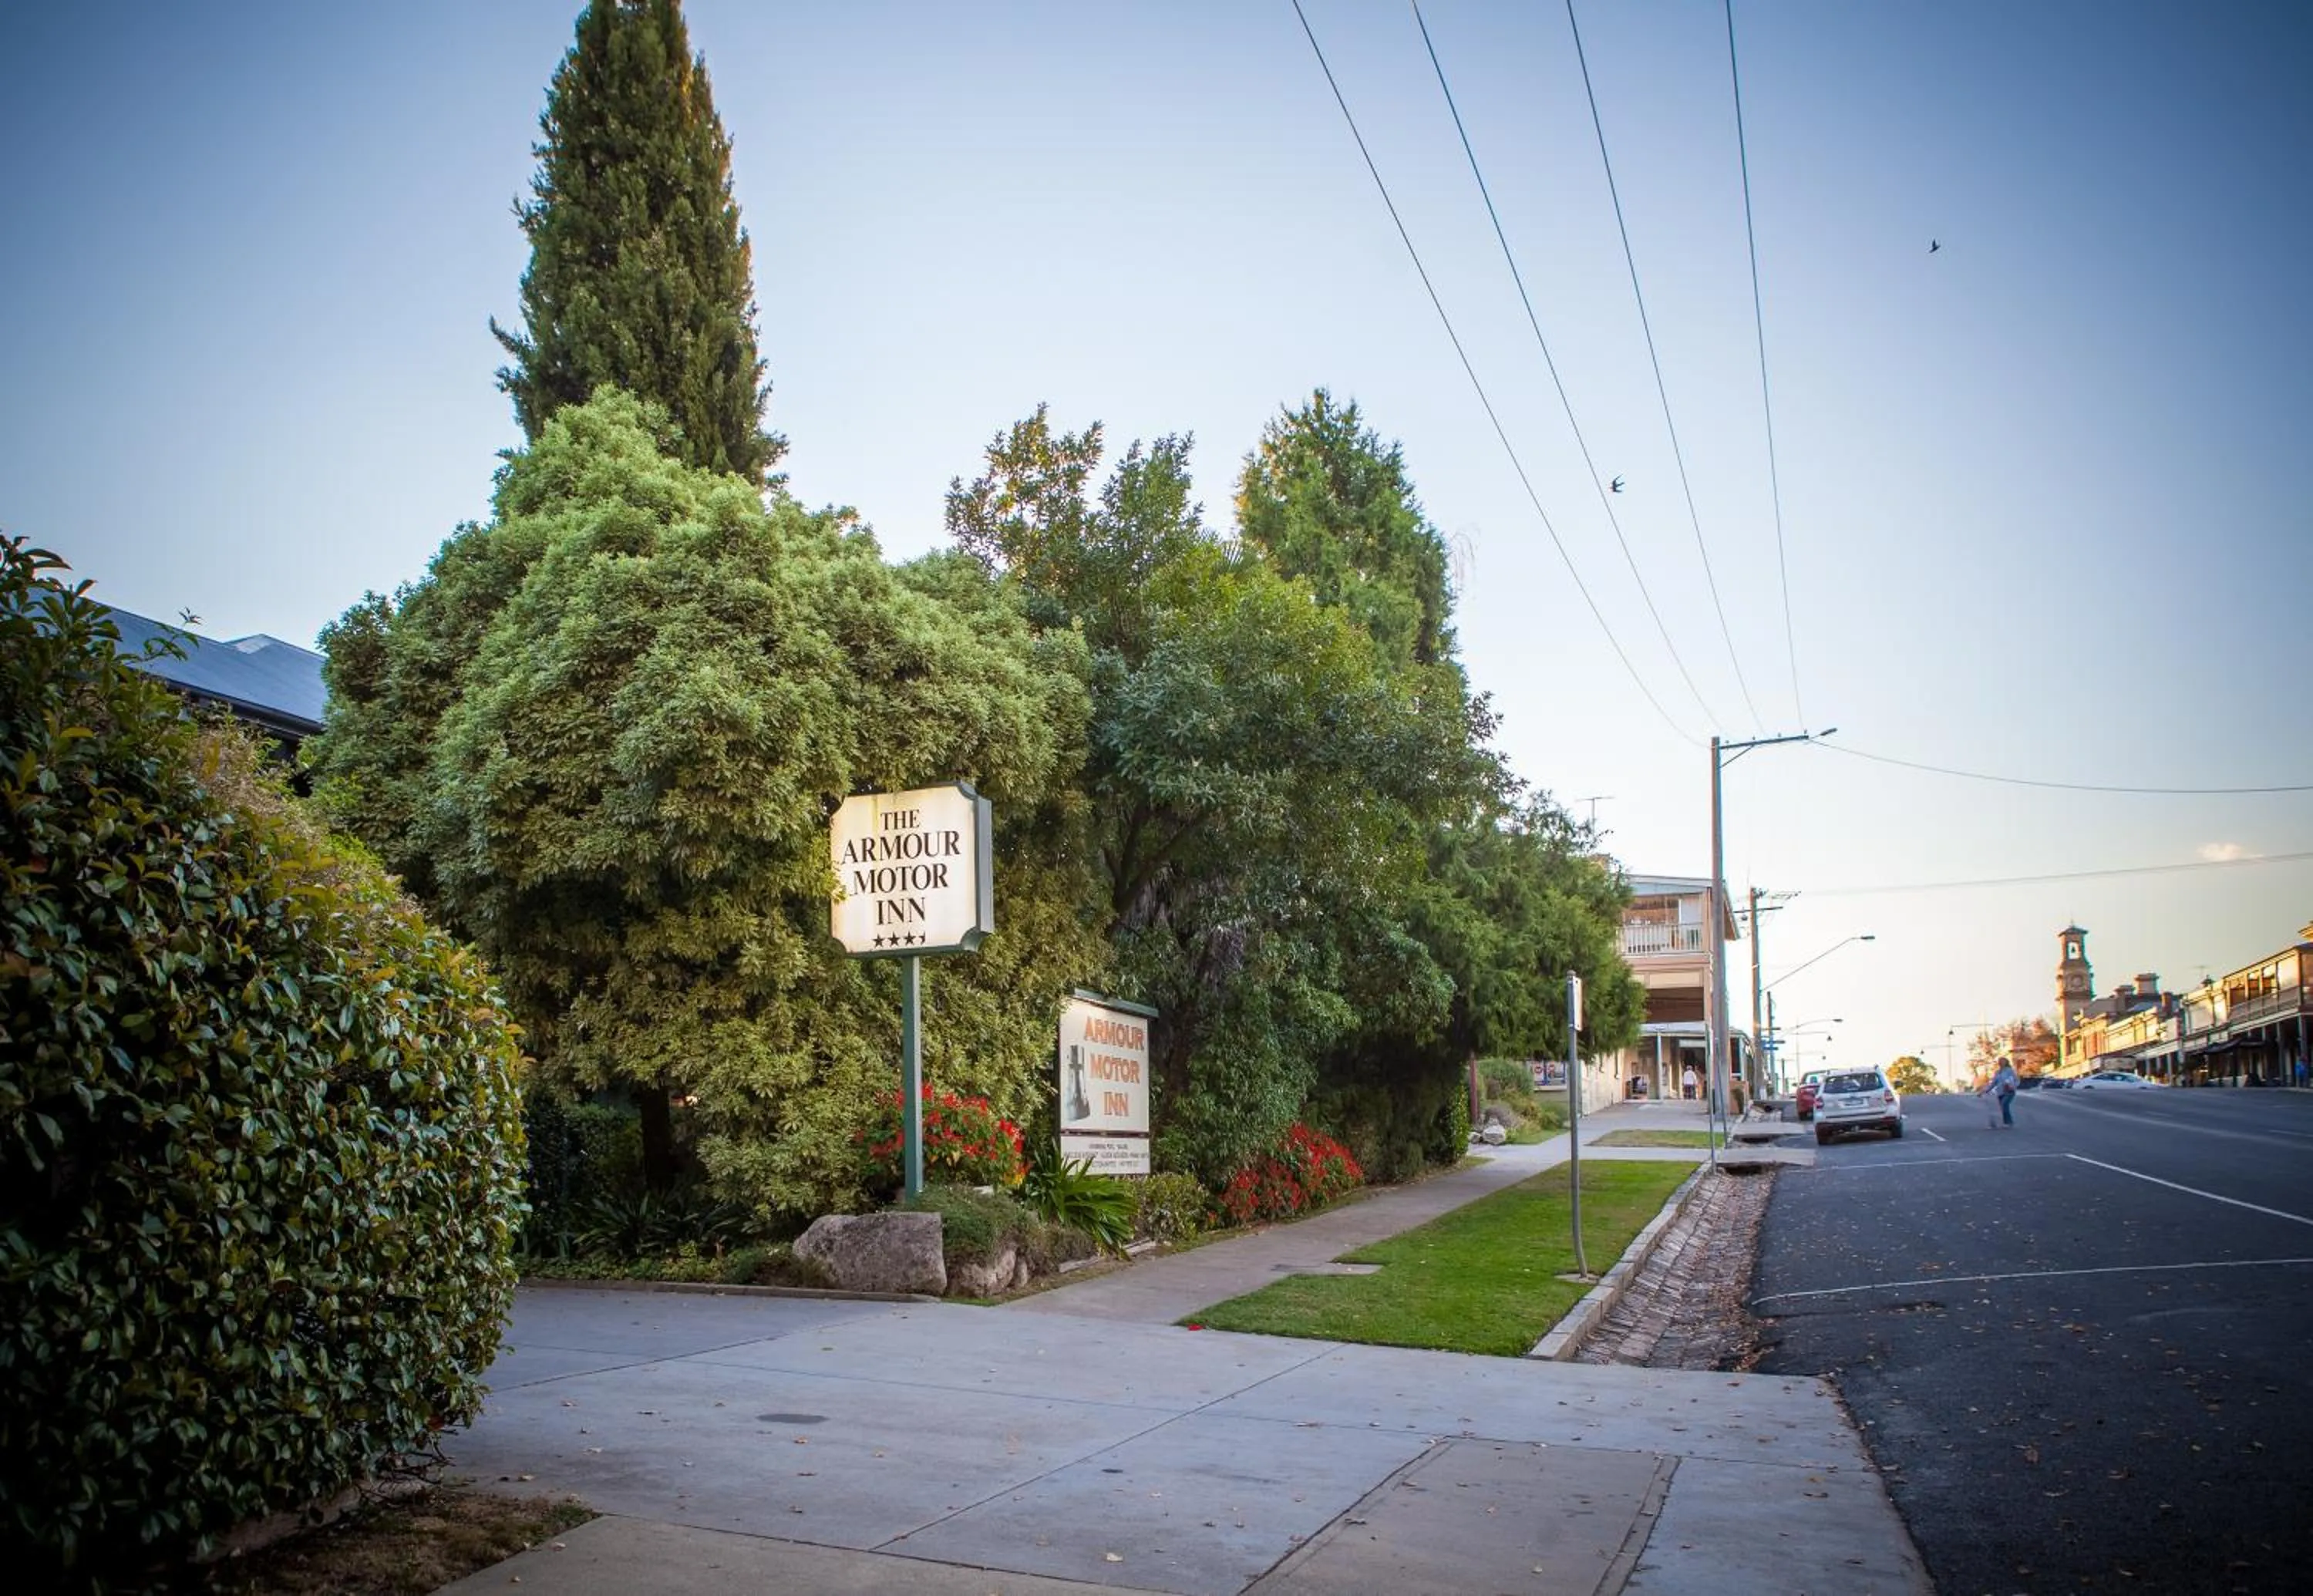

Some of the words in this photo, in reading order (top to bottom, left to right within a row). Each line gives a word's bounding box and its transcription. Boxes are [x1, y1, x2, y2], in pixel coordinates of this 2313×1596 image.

[880, 809, 920, 831] THE
[841, 830, 961, 864] ARMOUR
[850, 863, 948, 897] MOTOR
[876, 897, 926, 925] INN
[1084, 1016, 1145, 1050] ARMOUR
[1089, 1052, 1140, 1083] MOTOR
[1103, 1091, 1129, 1117] INN
